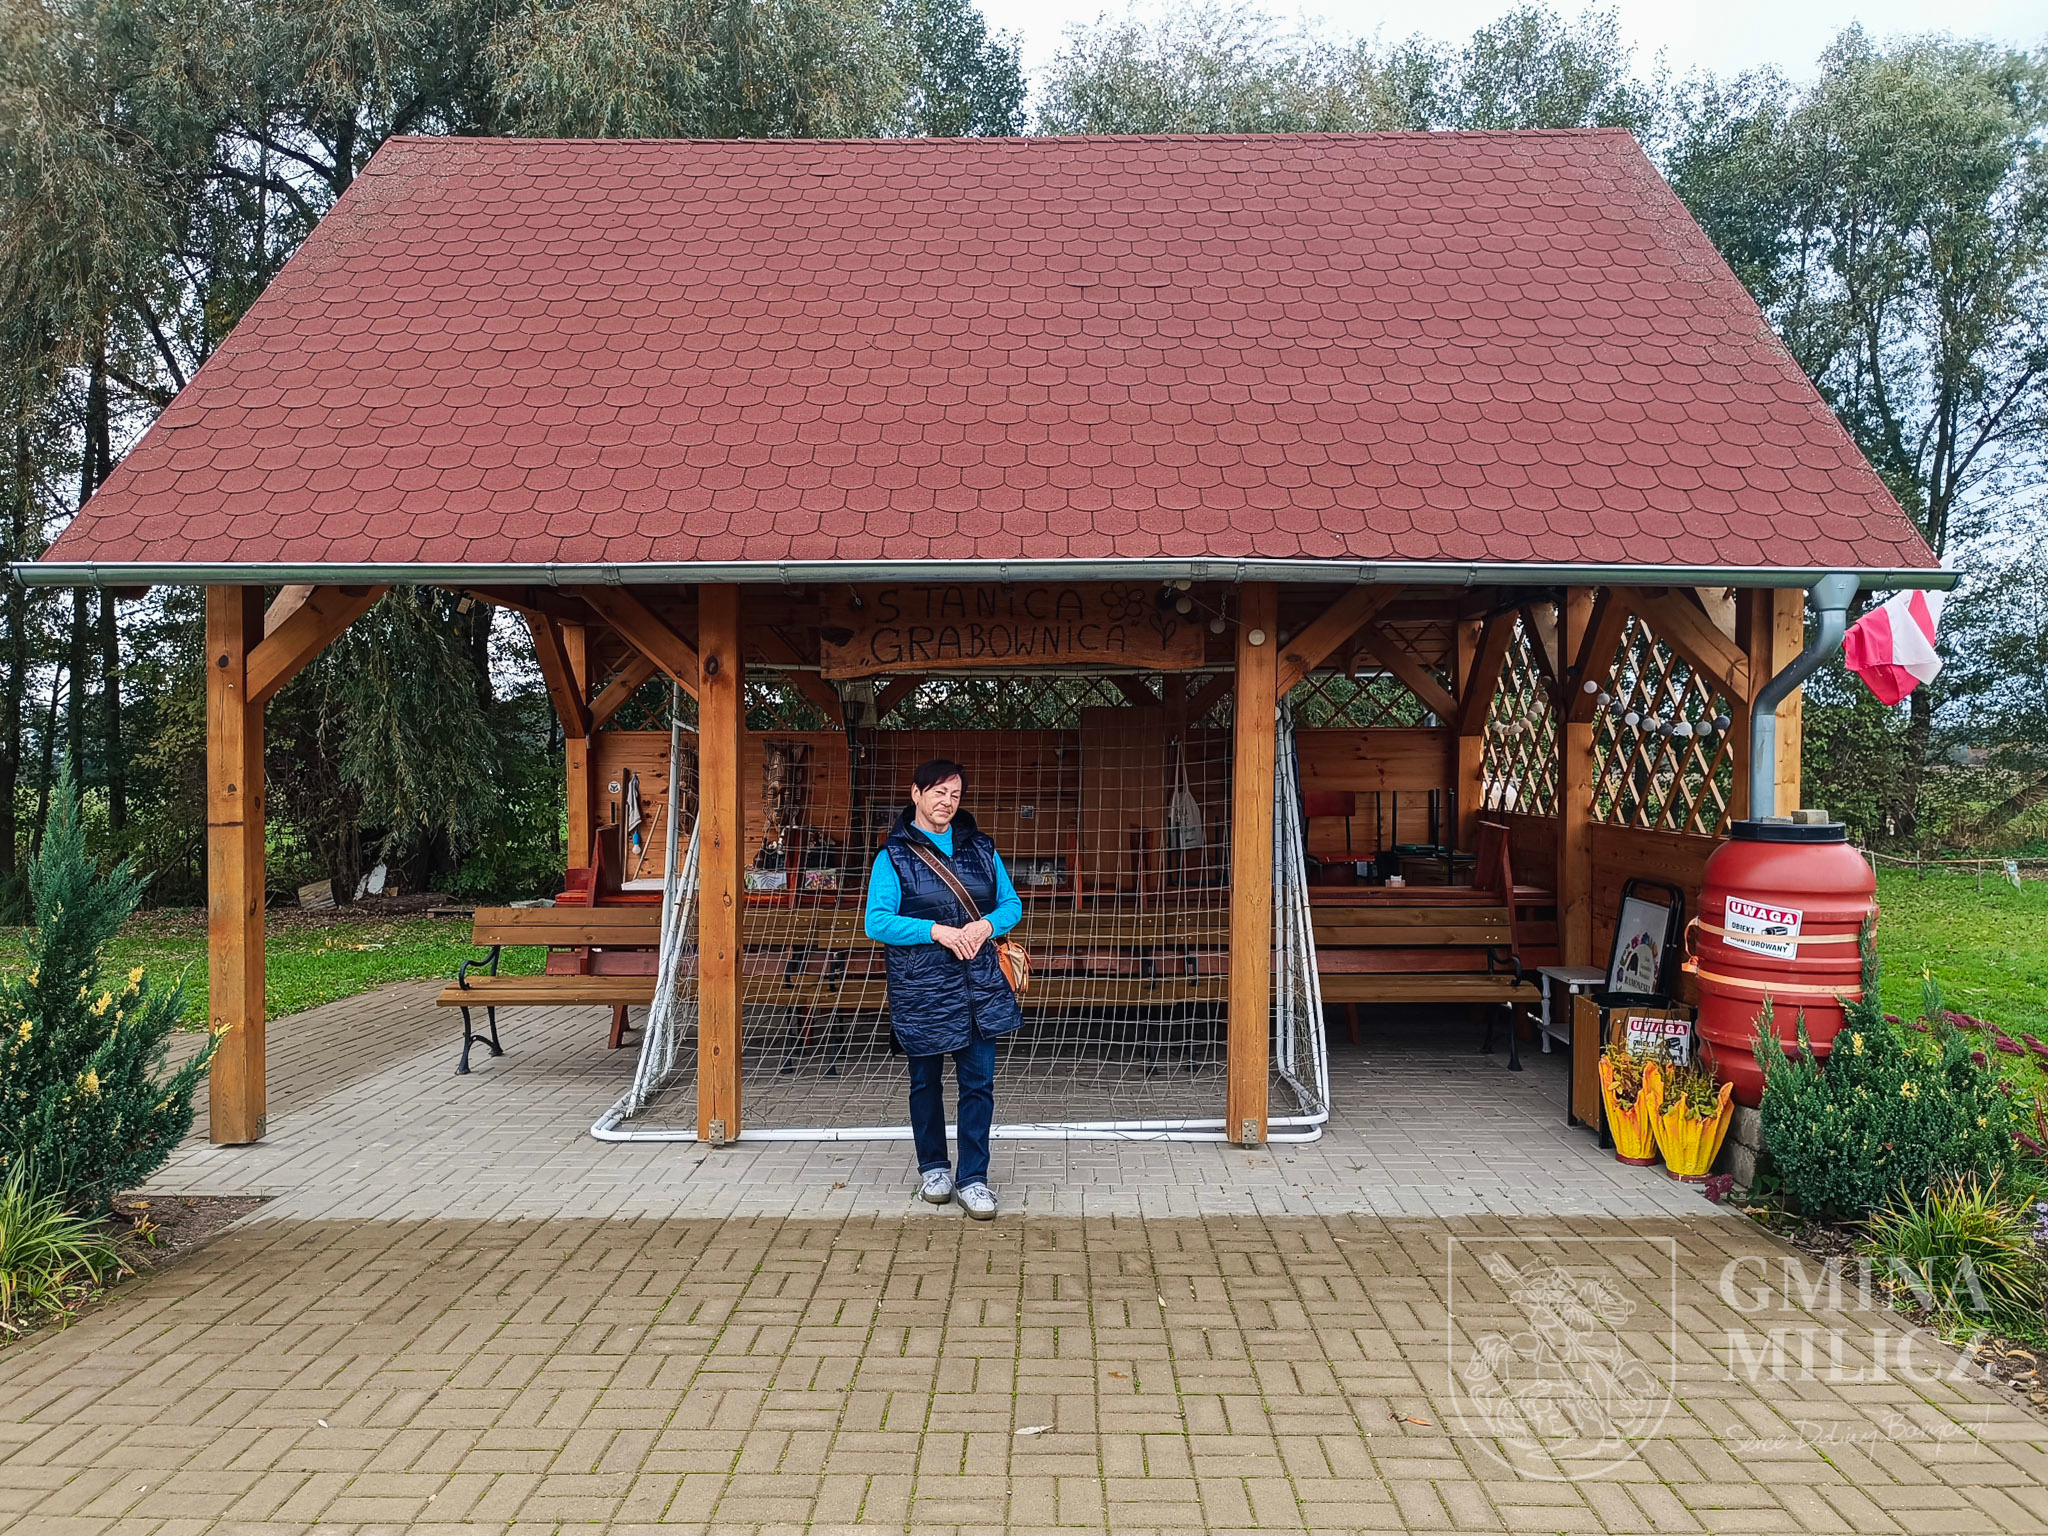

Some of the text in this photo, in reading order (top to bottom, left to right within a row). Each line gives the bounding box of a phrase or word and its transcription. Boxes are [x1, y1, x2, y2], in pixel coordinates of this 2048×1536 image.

[1731, 901, 1795, 925] UWAGA
[1731, 921, 1755, 934] OBIEKT
[1632, 1021, 1685, 1034] UWAGA
